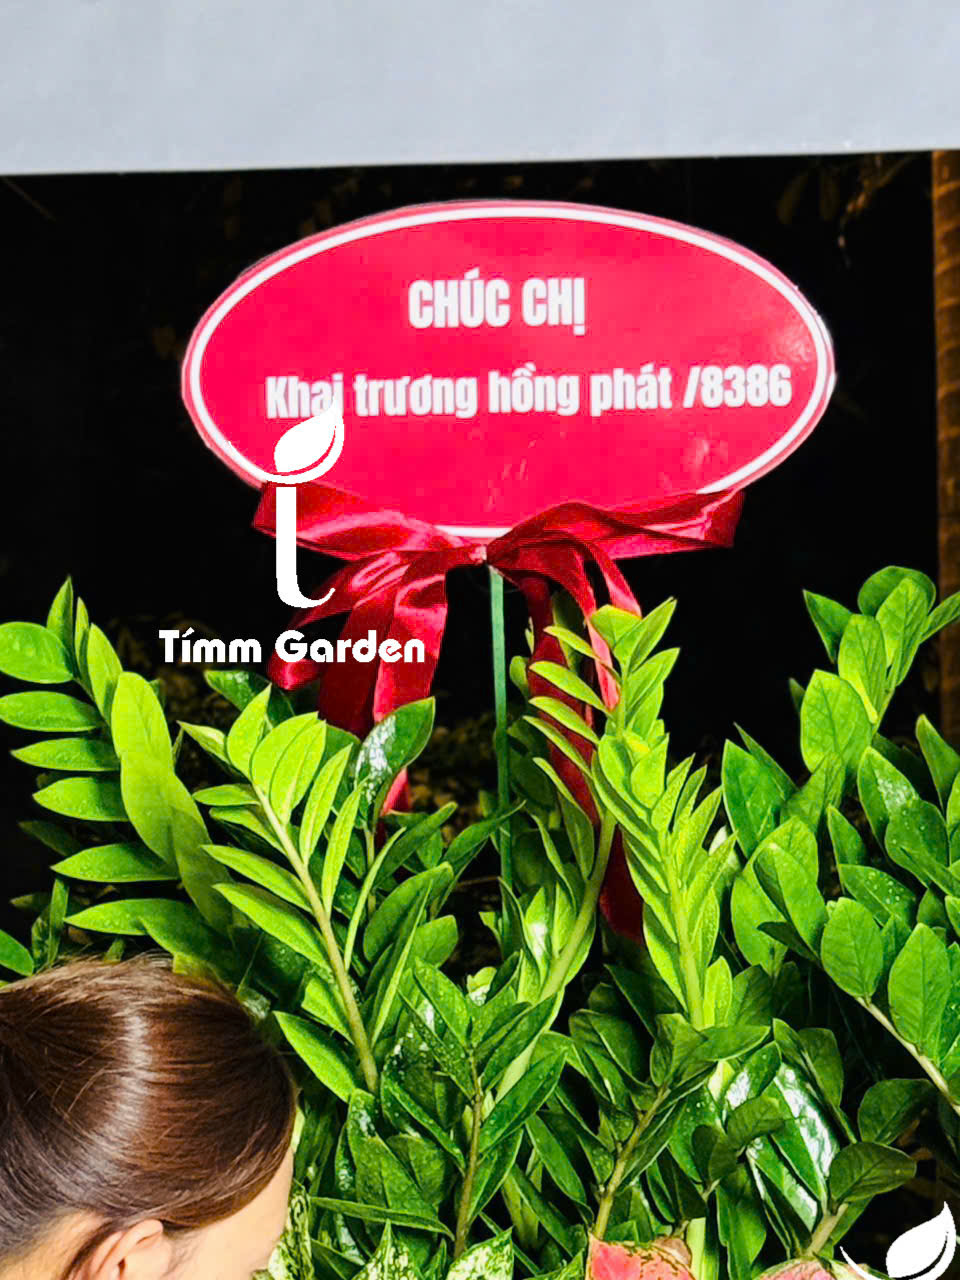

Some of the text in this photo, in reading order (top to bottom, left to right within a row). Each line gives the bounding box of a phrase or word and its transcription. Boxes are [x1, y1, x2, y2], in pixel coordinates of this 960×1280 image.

[408, 267, 585, 335] CHÚC CHỊ
[266, 362, 793, 419] Khai trương hồng phát /8386
